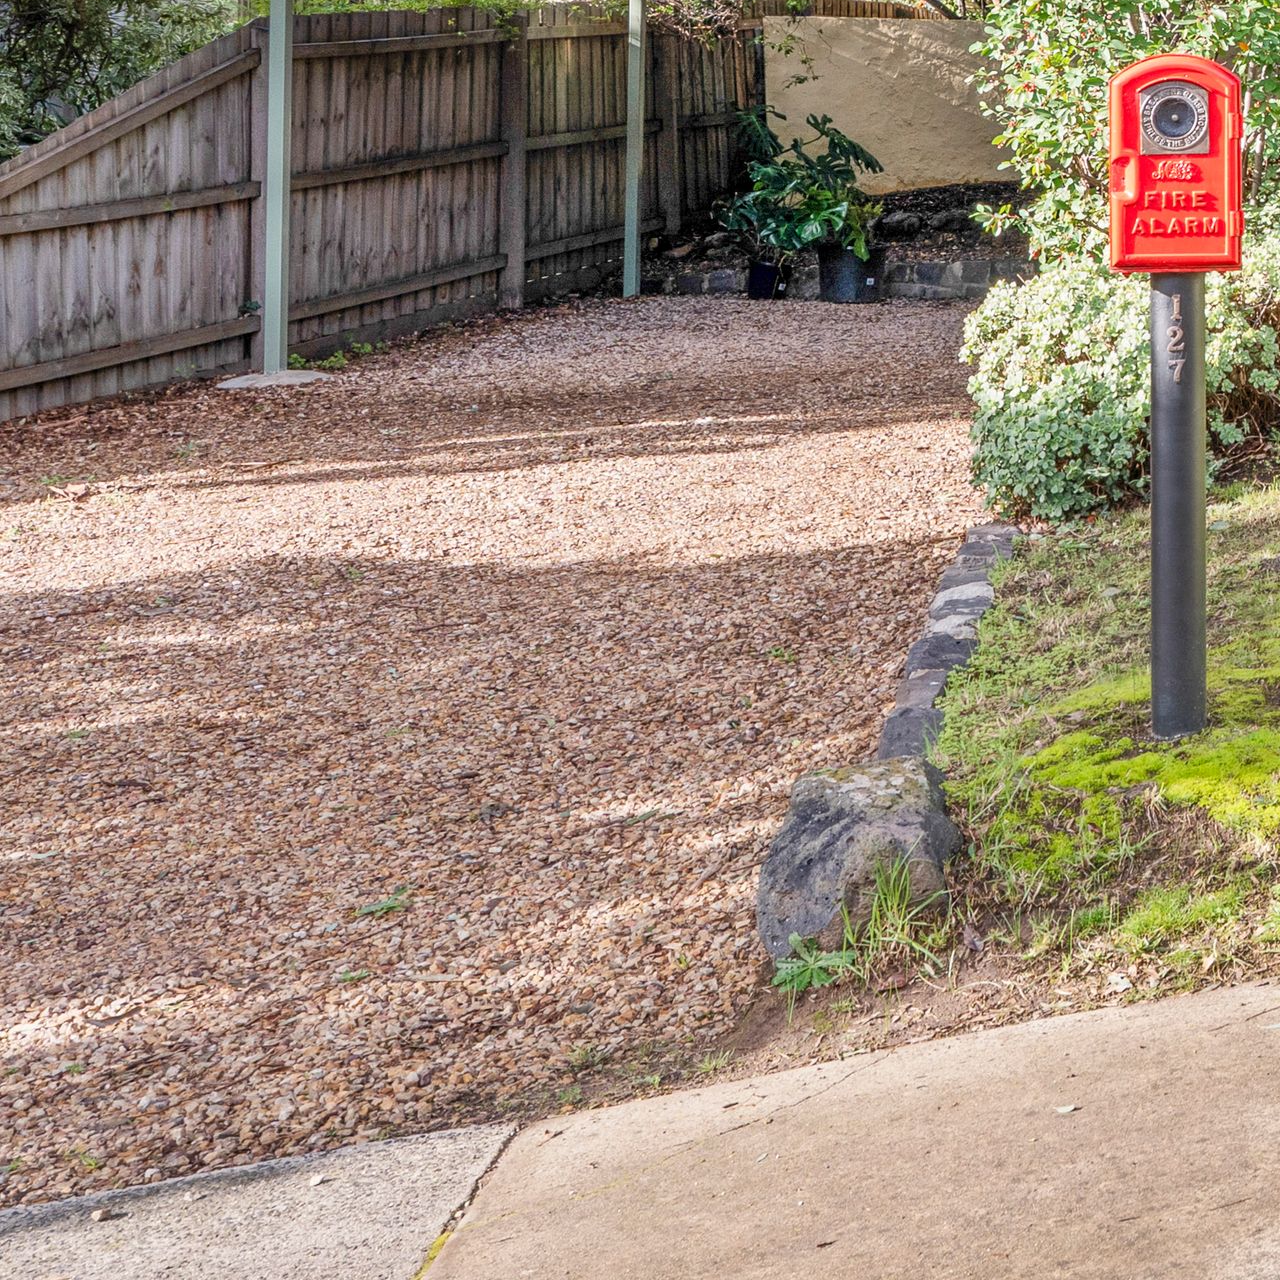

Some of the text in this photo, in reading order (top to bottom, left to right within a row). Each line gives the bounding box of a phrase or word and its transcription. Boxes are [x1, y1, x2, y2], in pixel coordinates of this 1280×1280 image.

[1144, 190, 1207, 208] FIRE
[1131, 216, 1219, 235] ALARM
[1166, 293, 1187, 384] 127
